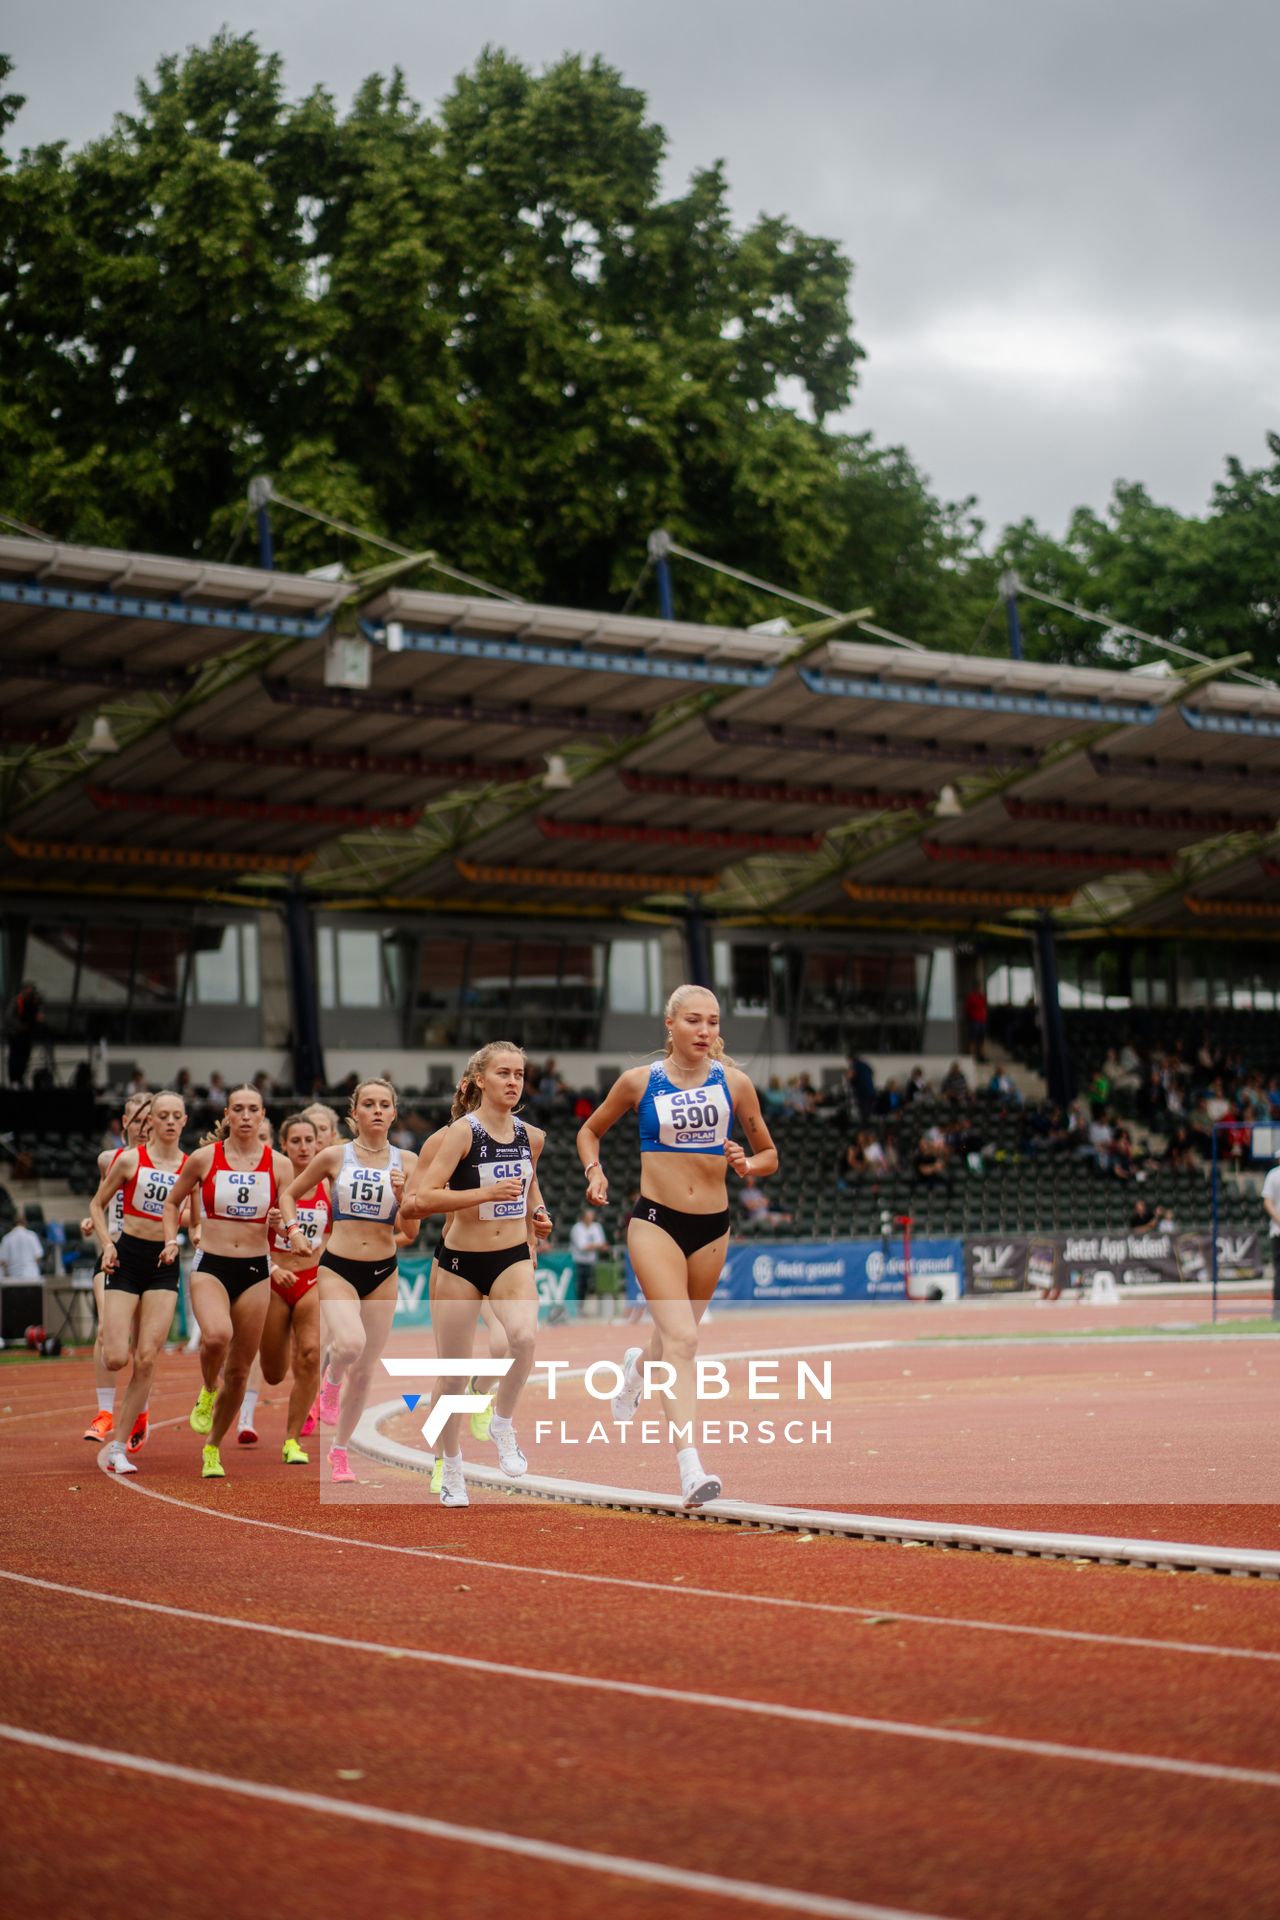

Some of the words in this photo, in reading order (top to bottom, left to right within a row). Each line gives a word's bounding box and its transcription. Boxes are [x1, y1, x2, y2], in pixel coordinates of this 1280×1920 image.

[671, 1090, 707, 1106] GLS
[671, 1104, 719, 1130] 590
[150, 1172, 176, 1186] GLS
[228, 1174, 256, 1185] GLS
[353, 1169, 381, 1182] GLS
[493, 1163, 522, 1179] GLS
[144, 1183, 171, 1202] 30
[237, 1186, 249, 1204] 8
[349, 1181, 384, 1203] 151
[361, 1204, 379, 1212] PLAN
[1064, 1237, 1099, 1261] Jetzt
[1100, 1236, 1127, 1264] App
